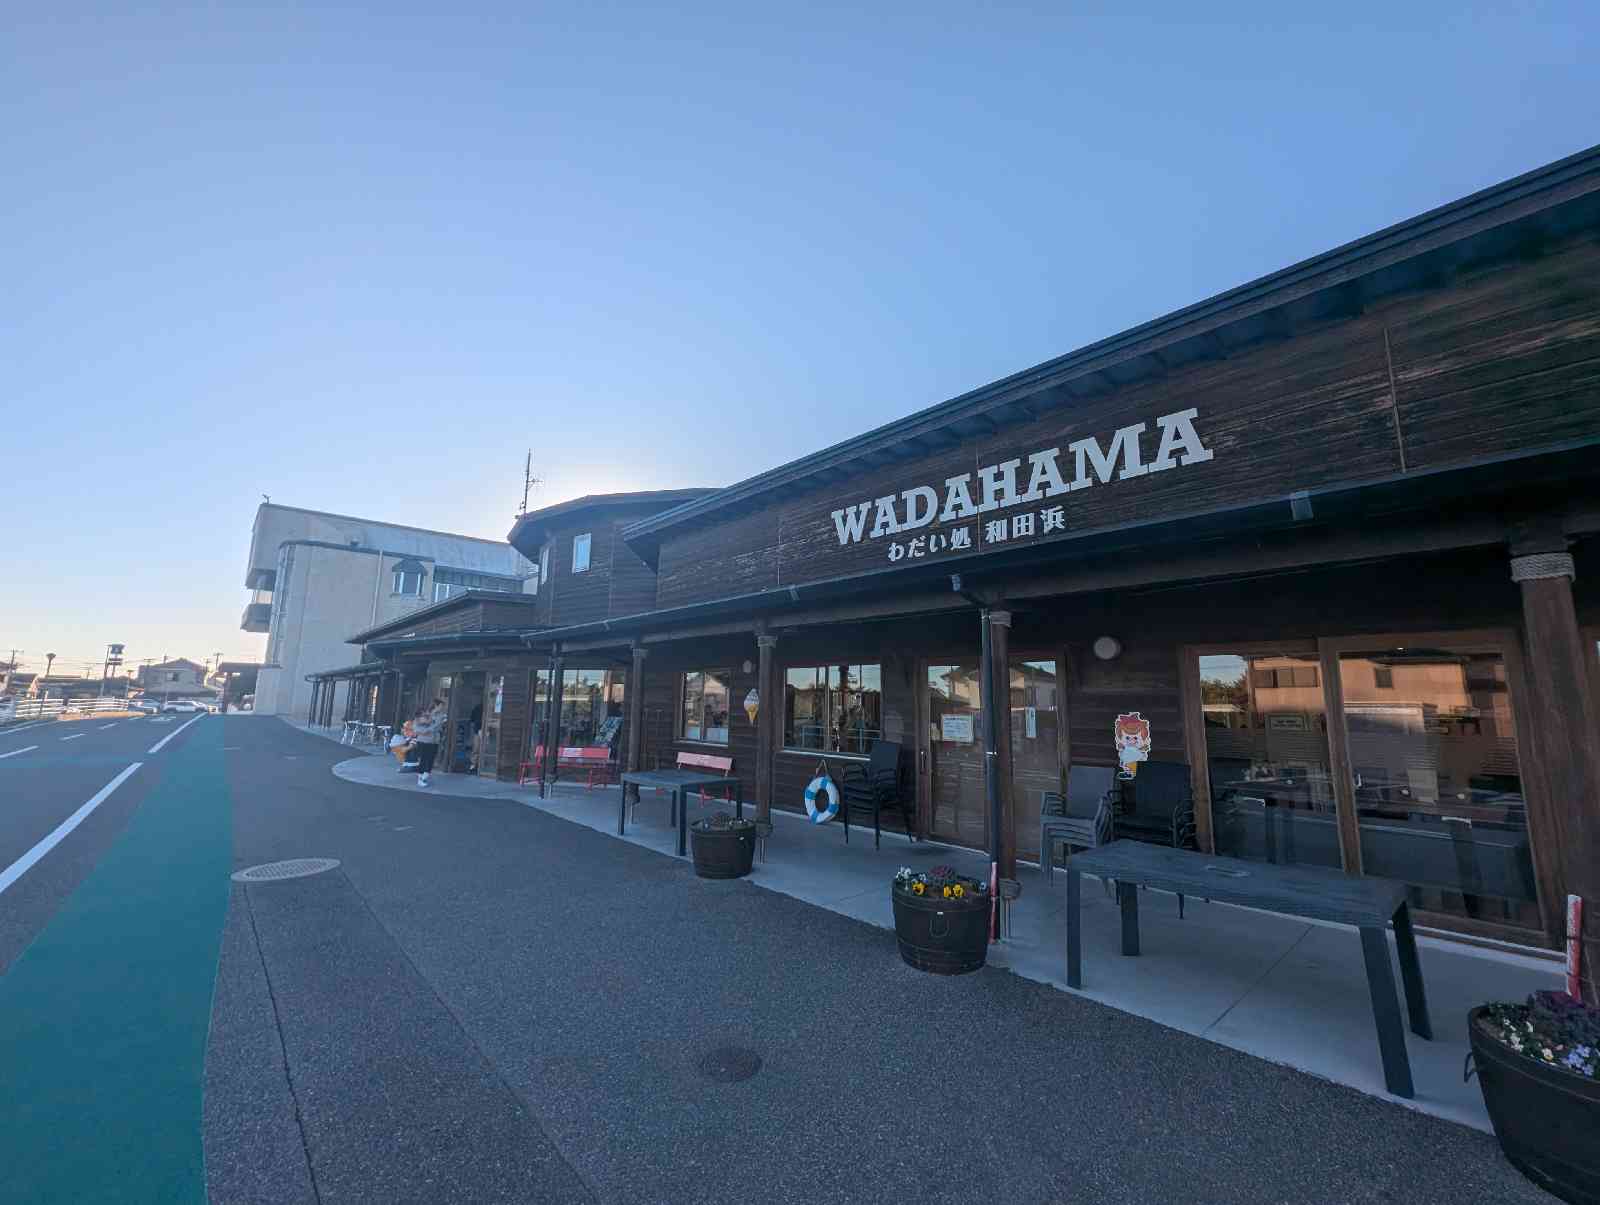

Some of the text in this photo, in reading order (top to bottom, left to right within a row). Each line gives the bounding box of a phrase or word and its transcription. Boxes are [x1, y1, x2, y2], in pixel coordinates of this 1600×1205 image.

[831, 407, 1214, 545] WADAHAMA
[887, 505, 1065, 562] わだい処 和田浜
